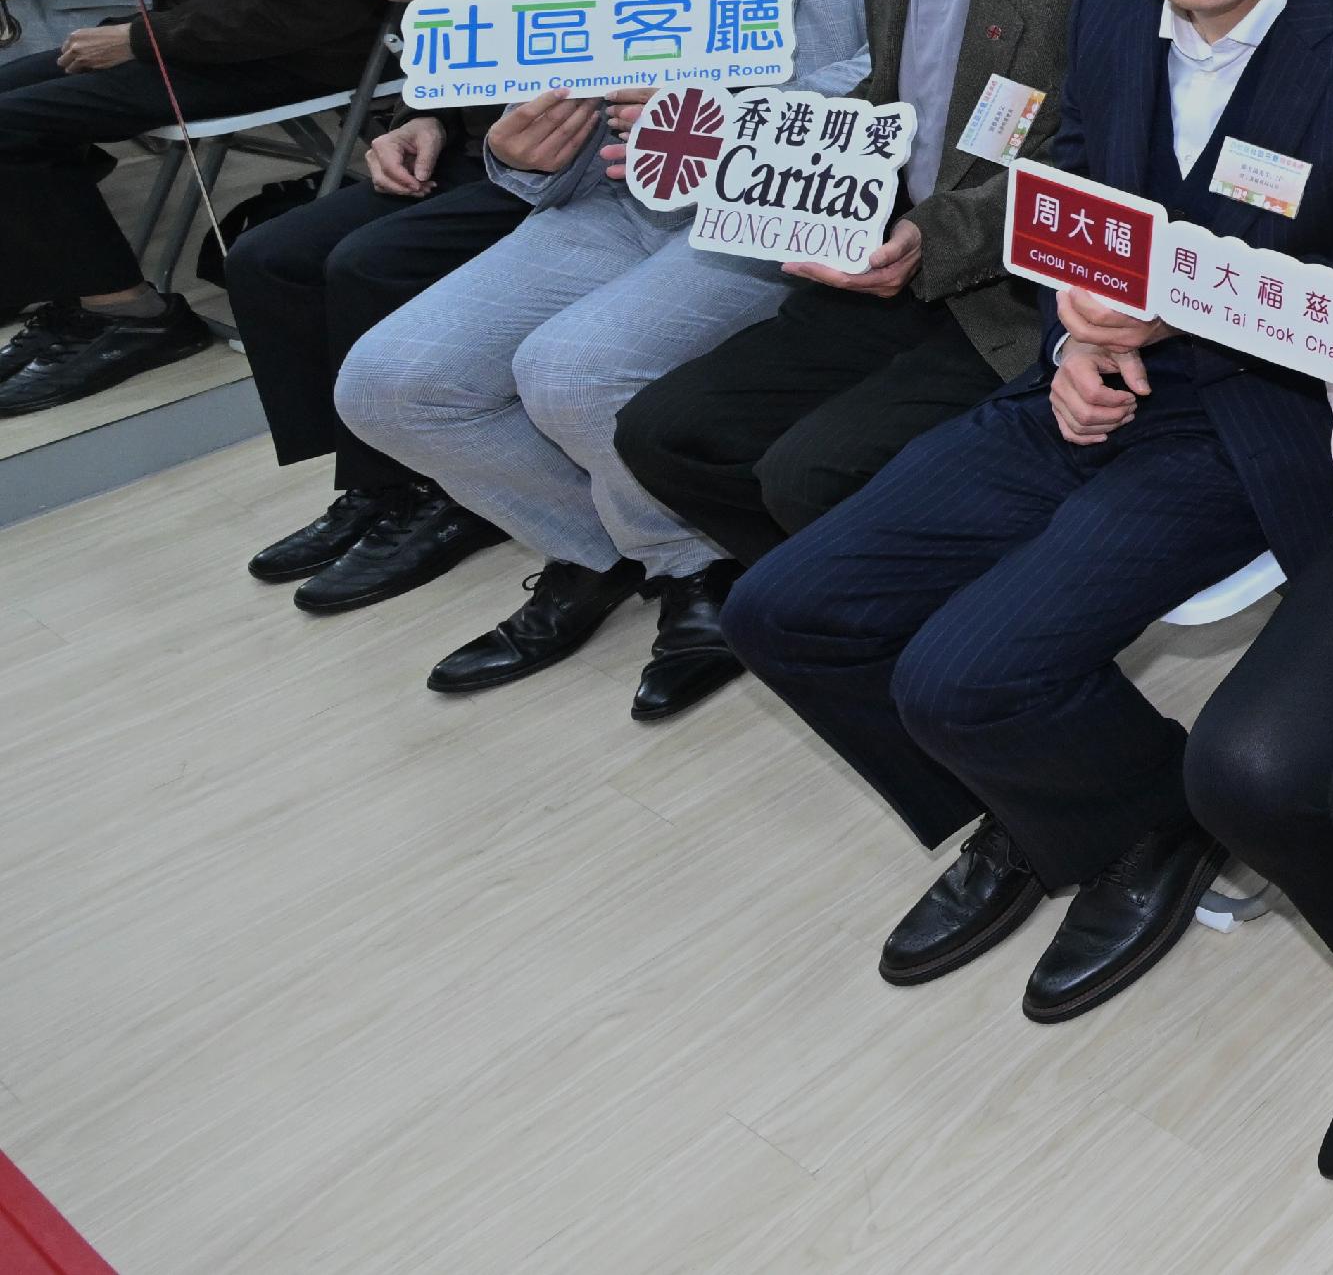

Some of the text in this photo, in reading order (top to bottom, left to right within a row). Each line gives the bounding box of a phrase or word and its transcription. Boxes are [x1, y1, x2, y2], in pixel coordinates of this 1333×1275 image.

[414, 63, 782, 99] Sai Ying Pun Community Living Room
[733, 98, 904, 160] 香港明愛
[714, 143, 884, 222] Caritas
[696, 206, 869, 263] HONG KONG
[1032, 192, 1132, 259] 周大福
[1029, 248, 1129, 294] CHOW TAI FOOK
[1169, 288, 1213, 317] Chow
[1223, 306, 1247, 328] Tai
[1256, 317, 1295, 346] Fook
